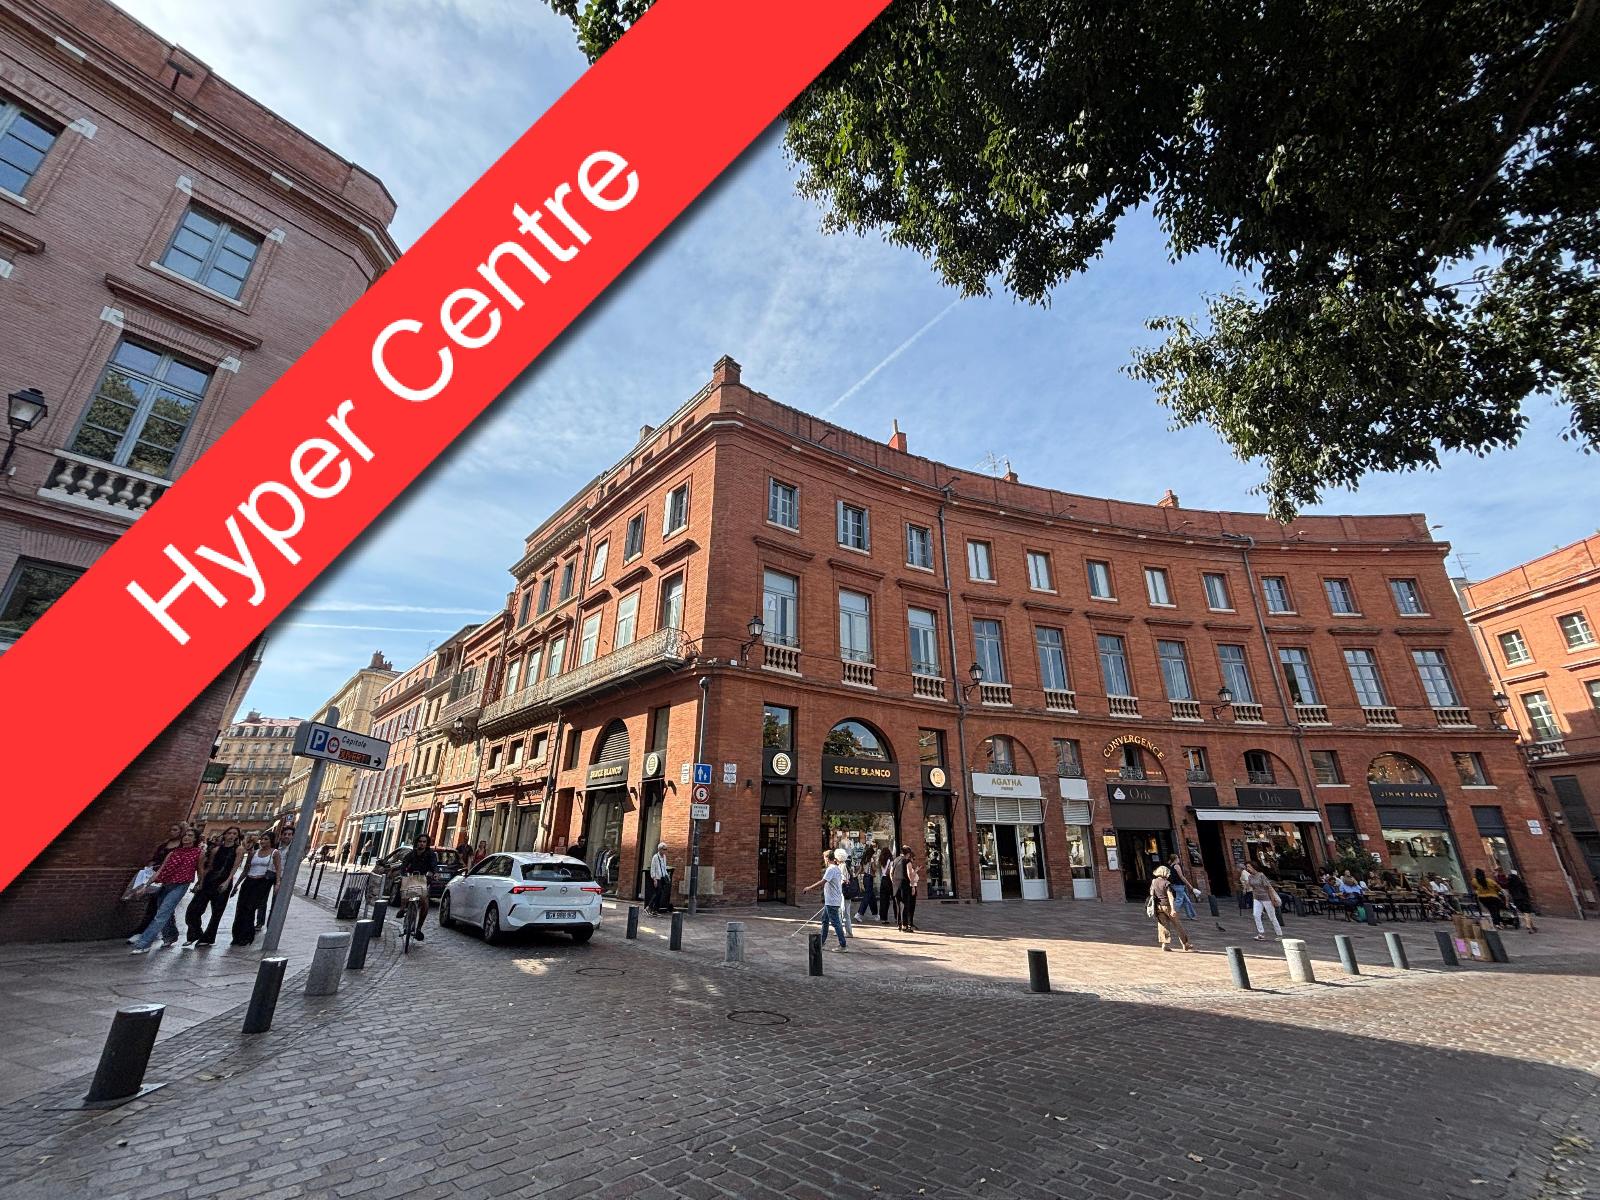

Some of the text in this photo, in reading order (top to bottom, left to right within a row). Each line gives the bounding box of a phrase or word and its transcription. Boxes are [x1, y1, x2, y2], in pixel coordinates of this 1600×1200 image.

[313, 730, 326, 749] P
[341, 735, 367, 749] Capitole
[1103, 734, 1165, 760] CONVERGENCE
[834, 765, 891, 778] SERGE BLANCO
[991, 777, 1023, 787] AGATHA
[698, 790, 704, 798] 6
